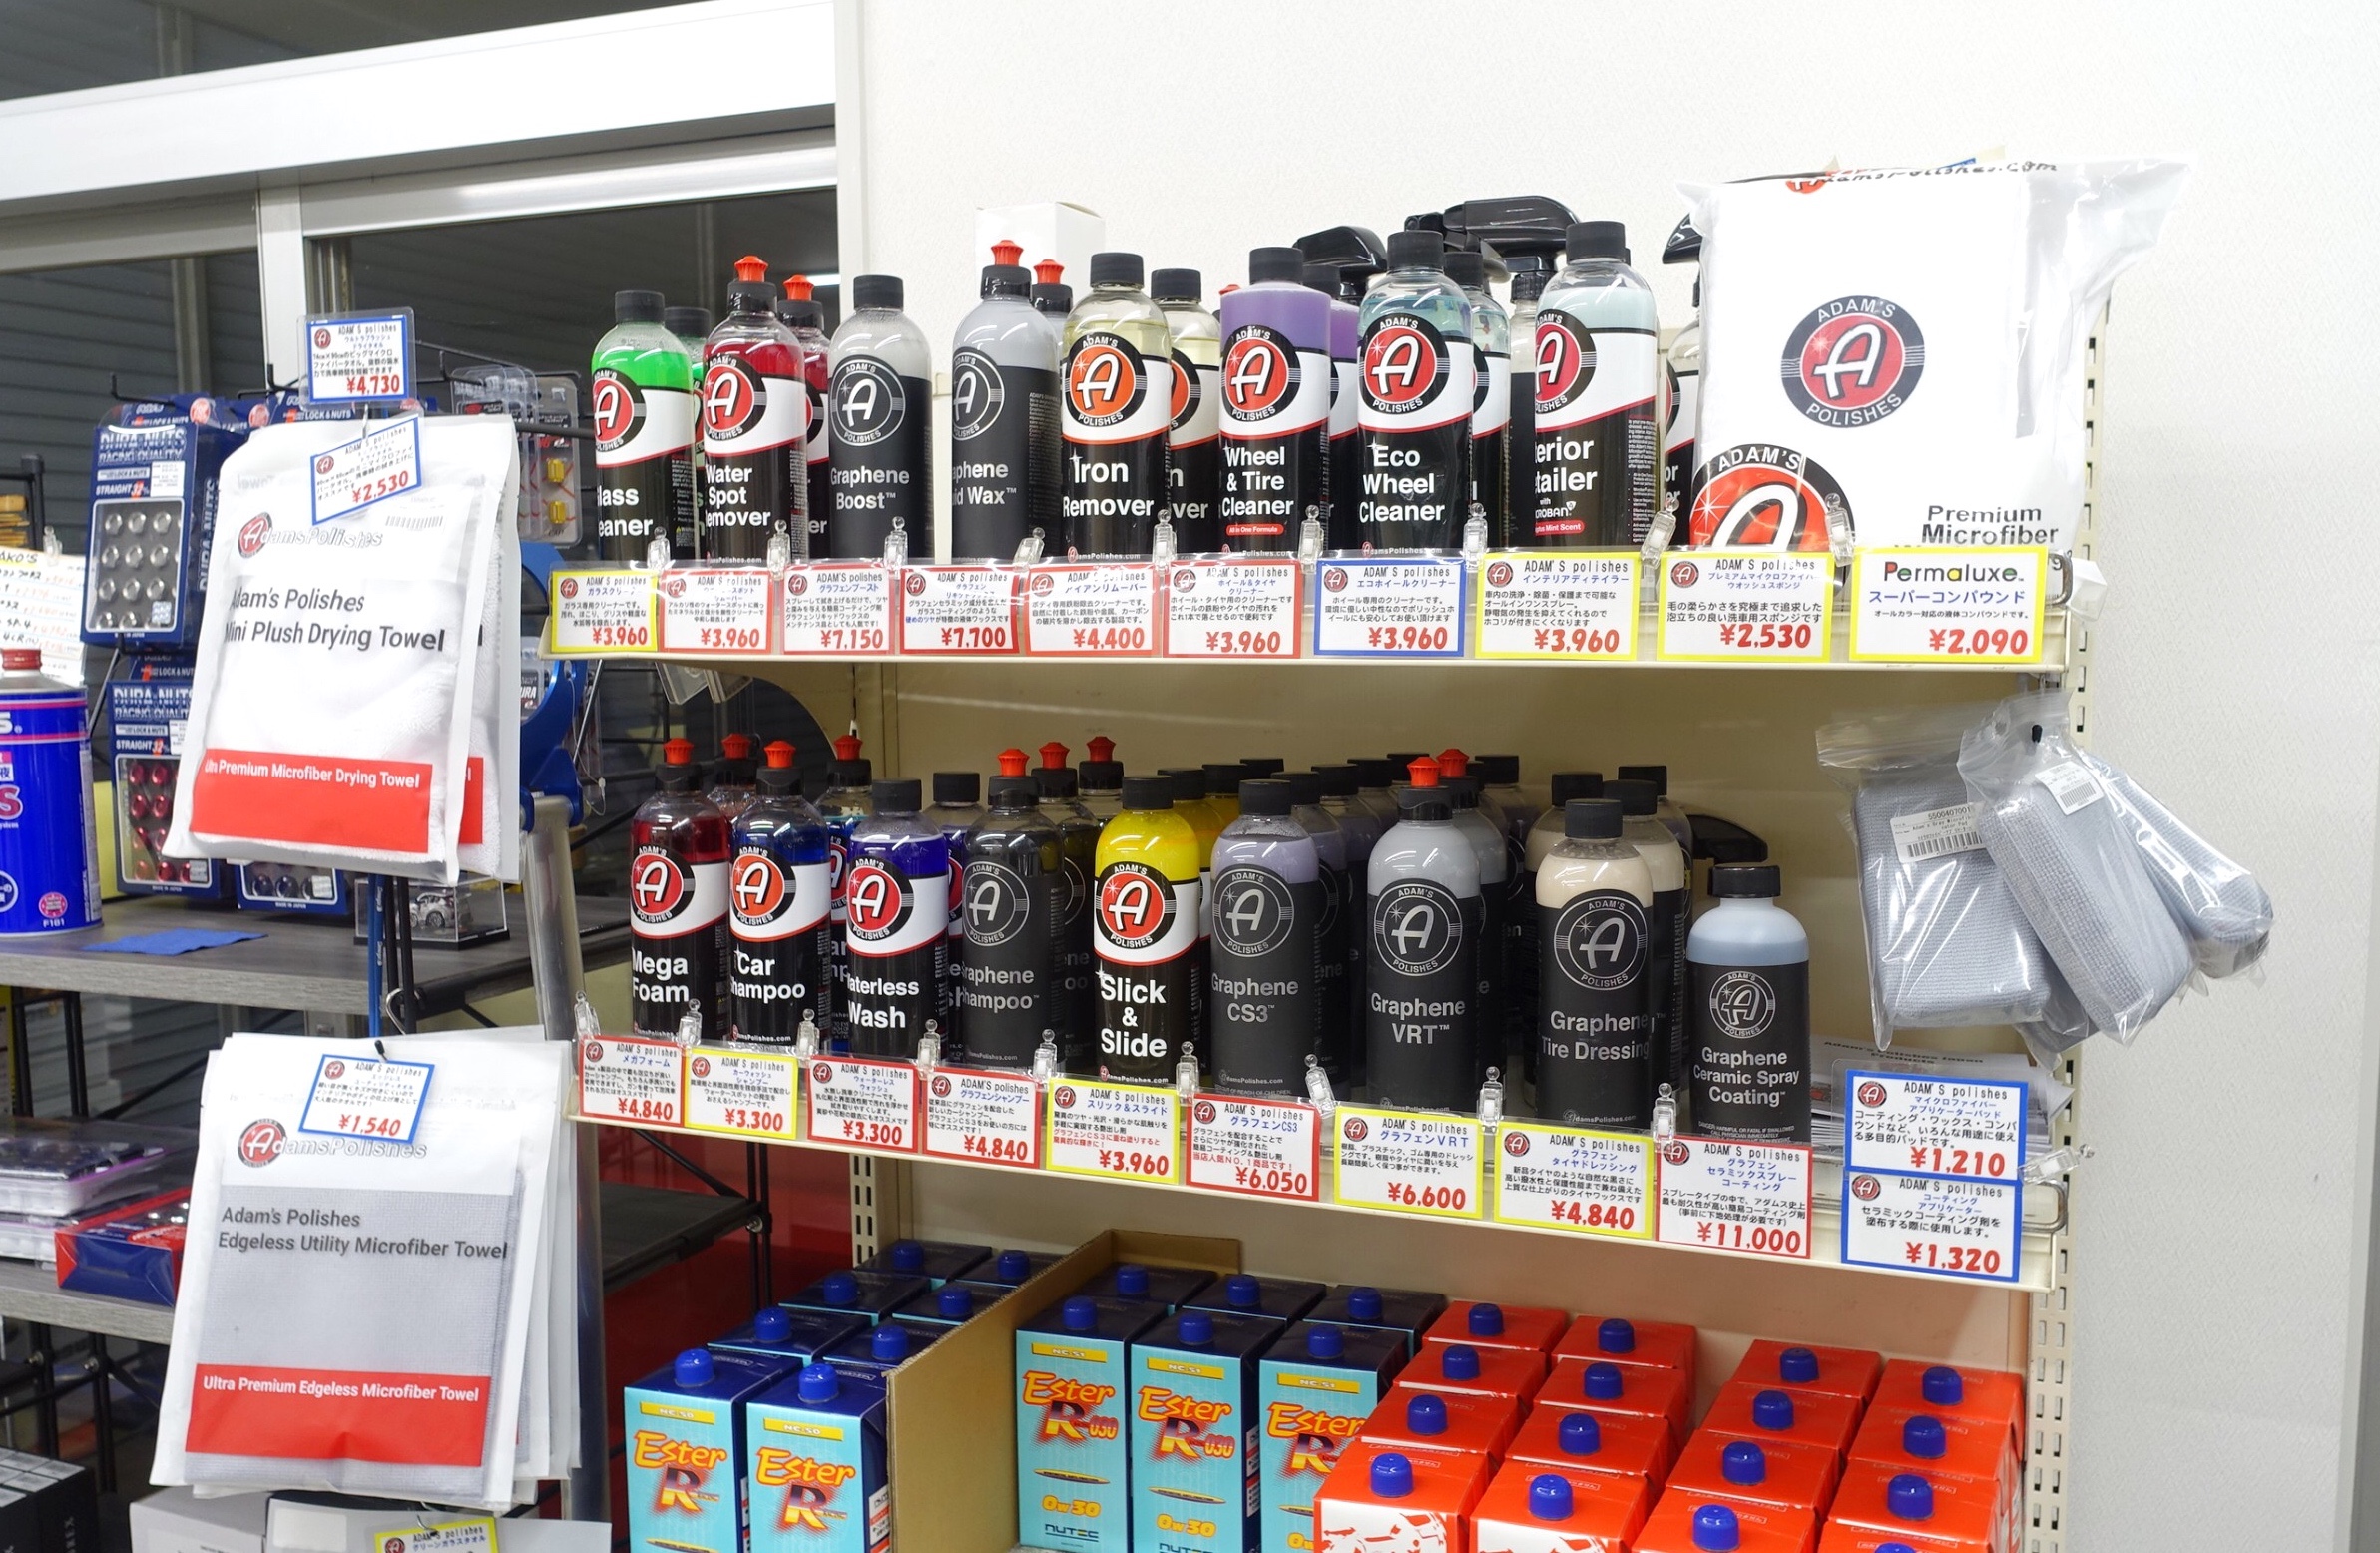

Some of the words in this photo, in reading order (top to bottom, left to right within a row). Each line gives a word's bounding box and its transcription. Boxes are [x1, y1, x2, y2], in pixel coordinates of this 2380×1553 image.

[1817, 297, 1897, 322] ADAM'S
[1379, 317, 1419, 330] ADAM'S
[1082, 335, 1119, 349] ADAM'S
[346, 374, 400, 394] ¥4,730
[1372, 398, 1424, 414] POLISHES
[1805, 392, 1902, 426] POLISHES
[1078, 412, 1124, 427] POLISHES
[1225, 445, 1285, 467] Wheel
[1373, 448, 1420, 466] Eco
[1717, 445, 1801, 471] ADAM'S
[830, 466, 910, 493] Graphene
[1074, 462, 1129, 483] Iron
[1227, 475, 1237, 492] &
[1242, 471, 1285, 490] Tire
[1362, 473, 1435, 494] Wheel
[96, 484, 132, 495] STRAIGHT
[351, 471, 410, 504] ¥2,530
[709, 487, 747, 506] Spot
[1063, 496, 1154, 516] Remover
[1222, 499, 1294, 516] Cleaner
[1359, 502, 1445, 522] Cleaner
[1927, 505, 2042, 523] Premium
[1922, 523, 2059, 546] Microfiber
[1404, 566, 1450, 578] polishes
[1573, 561, 1629, 574] polishes
[819, 584, 879, 593] グラフェンブースト
[1357, 579, 1456, 588] エコホイールクリーナー
[1523, 575, 1630, 585] インテリアディテイラー
[284, 589, 365, 612] Polishes
[1868, 590, 2027, 605] スーパーコンパウンド
[251, 622, 303, 644] Plush
[308, 625, 372, 651] Drying
[379, 626, 445, 652] Towel
[592, 627, 648, 646] ¥3,960
[701, 628, 760, 648] ¥3,960
[820, 629, 883, 650] ¥7,150
[941, 627, 1006, 648] ¥7,700
[1073, 628, 1144, 649] ¥4,400
[1205, 631, 1281, 653] ¥3,960
[1368, 627, 1448, 650] ¥3,960
[1534, 629, 1620, 653] ¥3,960
[1719, 624, 1812, 649] ¥2,530
[1929, 629, 2028, 655] ¥2,090
[219, 760, 268, 777] Premium
[271, 764, 332, 782] Microfiber
[335, 767, 376, 788] Drying
[380, 771, 420, 788] Towel
[737, 953, 775, 976] Car
[633, 977, 689, 1002] Foam
[1101, 975, 1167, 1004] Slick
[1211, 973, 1298, 999] Graphene
[847, 1000, 906, 1028] Wash
[1122, 1007, 1138, 1027] &
[1371, 992, 1465, 1020] Graphene
[1101, 1028, 1167, 1057] Slide
[1542, 1036, 1569, 1058] Tire
[623, 1055, 671, 1067] メガフォーム
[1702, 1047, 1787, 1069] Graphene
[1693, 1064, 1752, 1085] Ceramic
[1756, 1071, 1800, 1087] Spray
[960, 1089, 1030, 1103] グラフェンシャンプー
[1914, 1096, 1997, 1109] マイクロファイバー
[1952, 1086, 2008, 1101] polishes
[618, 1097, 674, 1121] ¥4,840
[1087, 1100, 1168, 1114] スリック&スライド
[337, 1113, 401, 1137] ¥1,540
[725, 1108, 783, 1131] ¥3,300
[1230, 1116, 1298, 1133] グラフェンCS3
[843, 1120, 902, 1145] ¥3,300
[1380, 1130, 1469, 1148] グラフェンVRT
[964, 1135, 1028, 1160] ¥4,840
[1571, 1149, 1618, 1160] グラフェン
[1099, 1150, 1169, 1176] ¥3,960
[1552, 1158, 1638, 1173] タイヤドレッシング
[1727, 1158, 1776, 1170] グラフェン
[1910, 1147, 2005, 1176] ¥1,210
[1235, 1167, 1307, 1194] ¥6,050
[1706, 1167, 1797, 1182] セラミックスプレー
[1721, 1179, 1781, 1192] コーティング
[1388, 1182, 1466, 1210] ¥6,600
[1924, 1193, 1978, 1206] コーティング
[222, 1206, 281, 1225] Adam's
[286, 1210, 361, 1229] Polishes
[1552, 1201, 1635, 1230] ¥4,840
[1918, 1202, 1982, 1214] アプリケーター
[218, 1233, 295, 1252] Edgeless
[300, 1235, 350, 1257] Utility
[354, 1237, 449, 1257] Microfiber
[454, 1240, 508, 1261] Towel
[1696, 1222, 1801, 1254] ¥11,000
[1905, 1242, 2001, 1274] ¥1,320
[202, 1376, 236, 1391] Ultra
[238, 1378, 297, 1395] Premium
[298, 1380, 358, 1399] Edgeless
[361, 1383, 437, 1401] Microfiber
[439, 1386, 479, 1402] Towel
[1022, 1370, 1116, 1405] Ester
[1138, 1386, 1232, 1422] Ester
[633, 1430, 727, 1470] Ester
[756, 1447, 855, 1486] Ester
